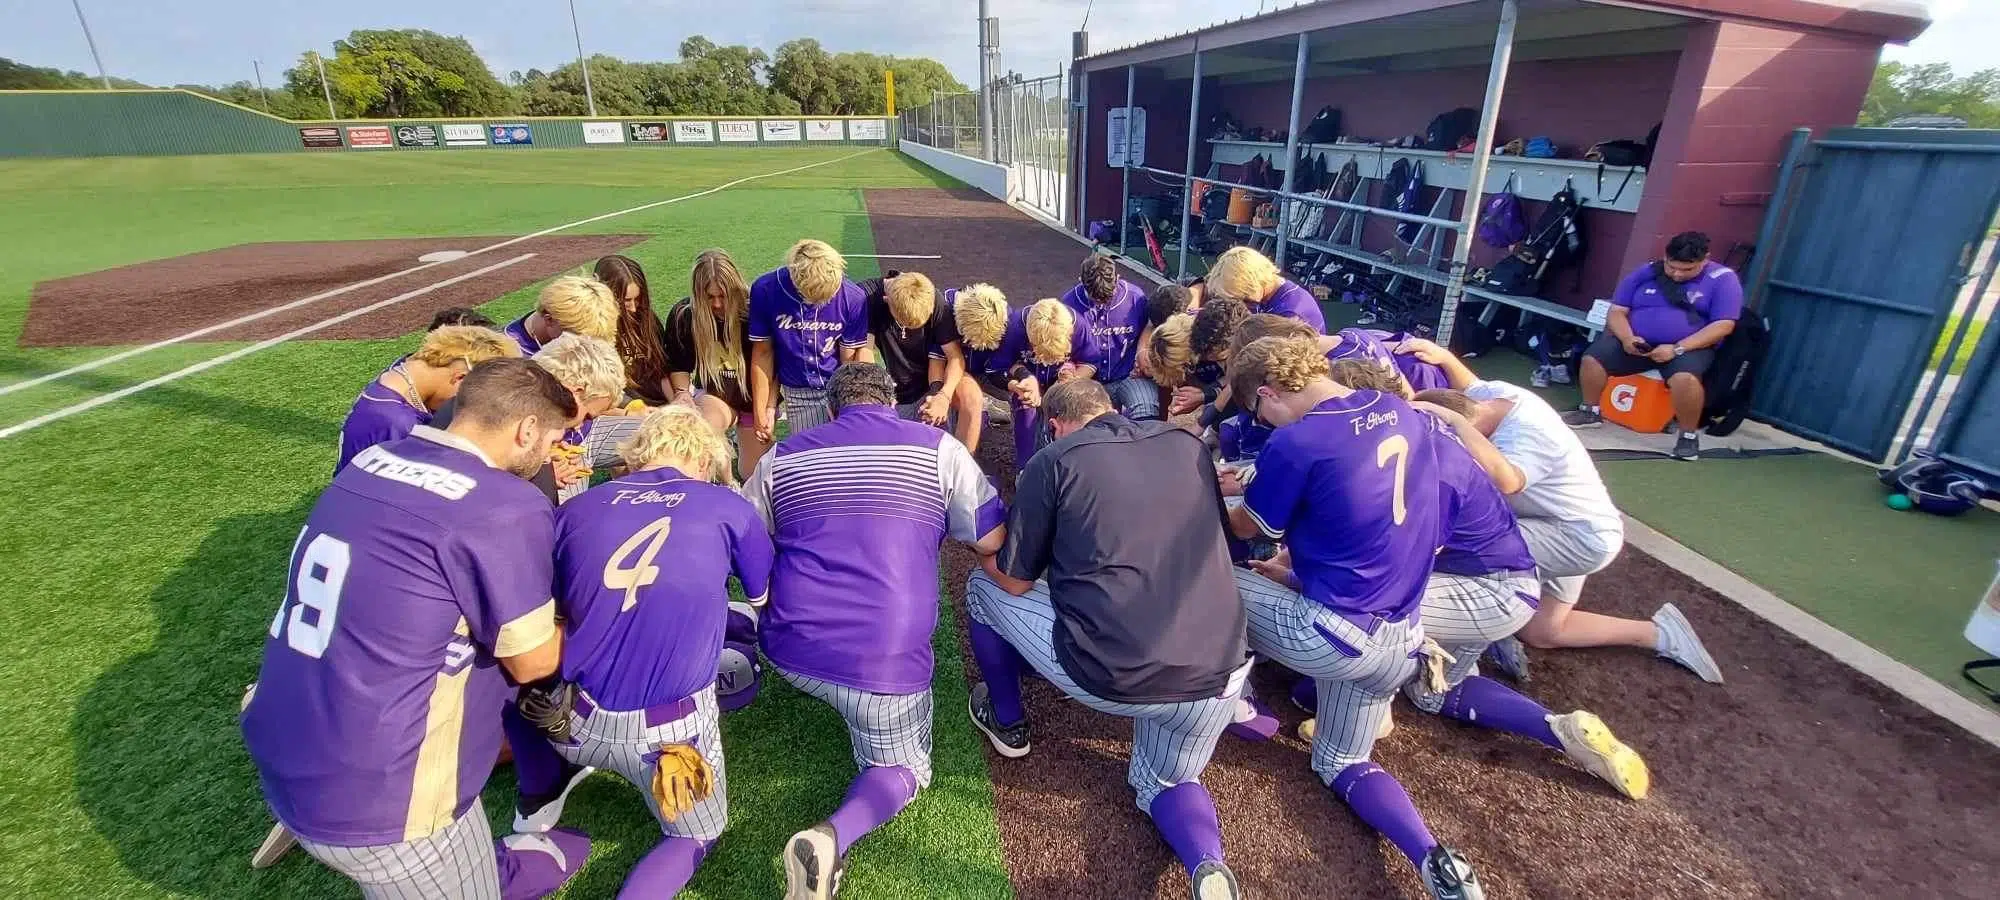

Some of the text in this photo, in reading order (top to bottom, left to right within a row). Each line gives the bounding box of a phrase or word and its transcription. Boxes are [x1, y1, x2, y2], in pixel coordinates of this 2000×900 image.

[775, 314, 843, 331] Navarro
[1350, 410, 1399, 435] T-Strong
[1376, 434, 1409, 526] 7
[611, 489, 688, 508] T-Strong
[603, 516, 672, 613] 4
[716, 670, 736, 691] N
